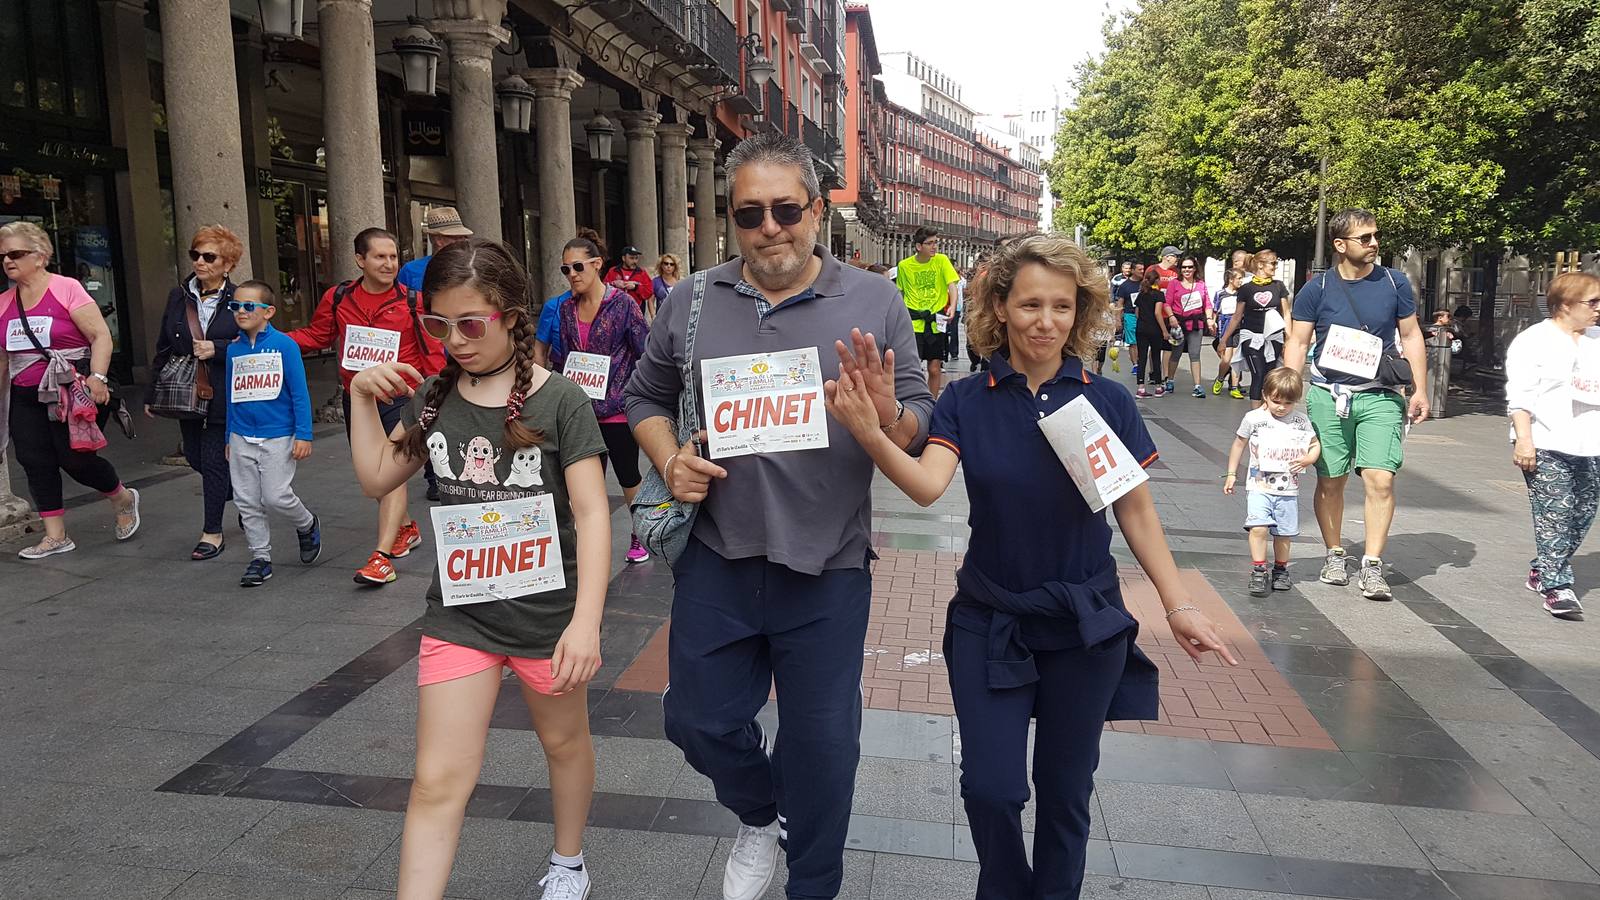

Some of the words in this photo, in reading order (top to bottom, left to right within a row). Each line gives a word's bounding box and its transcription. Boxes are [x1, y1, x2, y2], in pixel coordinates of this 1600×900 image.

[347, 345, 395, 363] GARMAR
[234, 373, 280, 390] GARMAR
[714, 392, 817, 433] CHINET
[450, 485, 466, 496] SHORT
[468, 488, 476, 498] TO
[447, 536, 552, 581] CHINET
